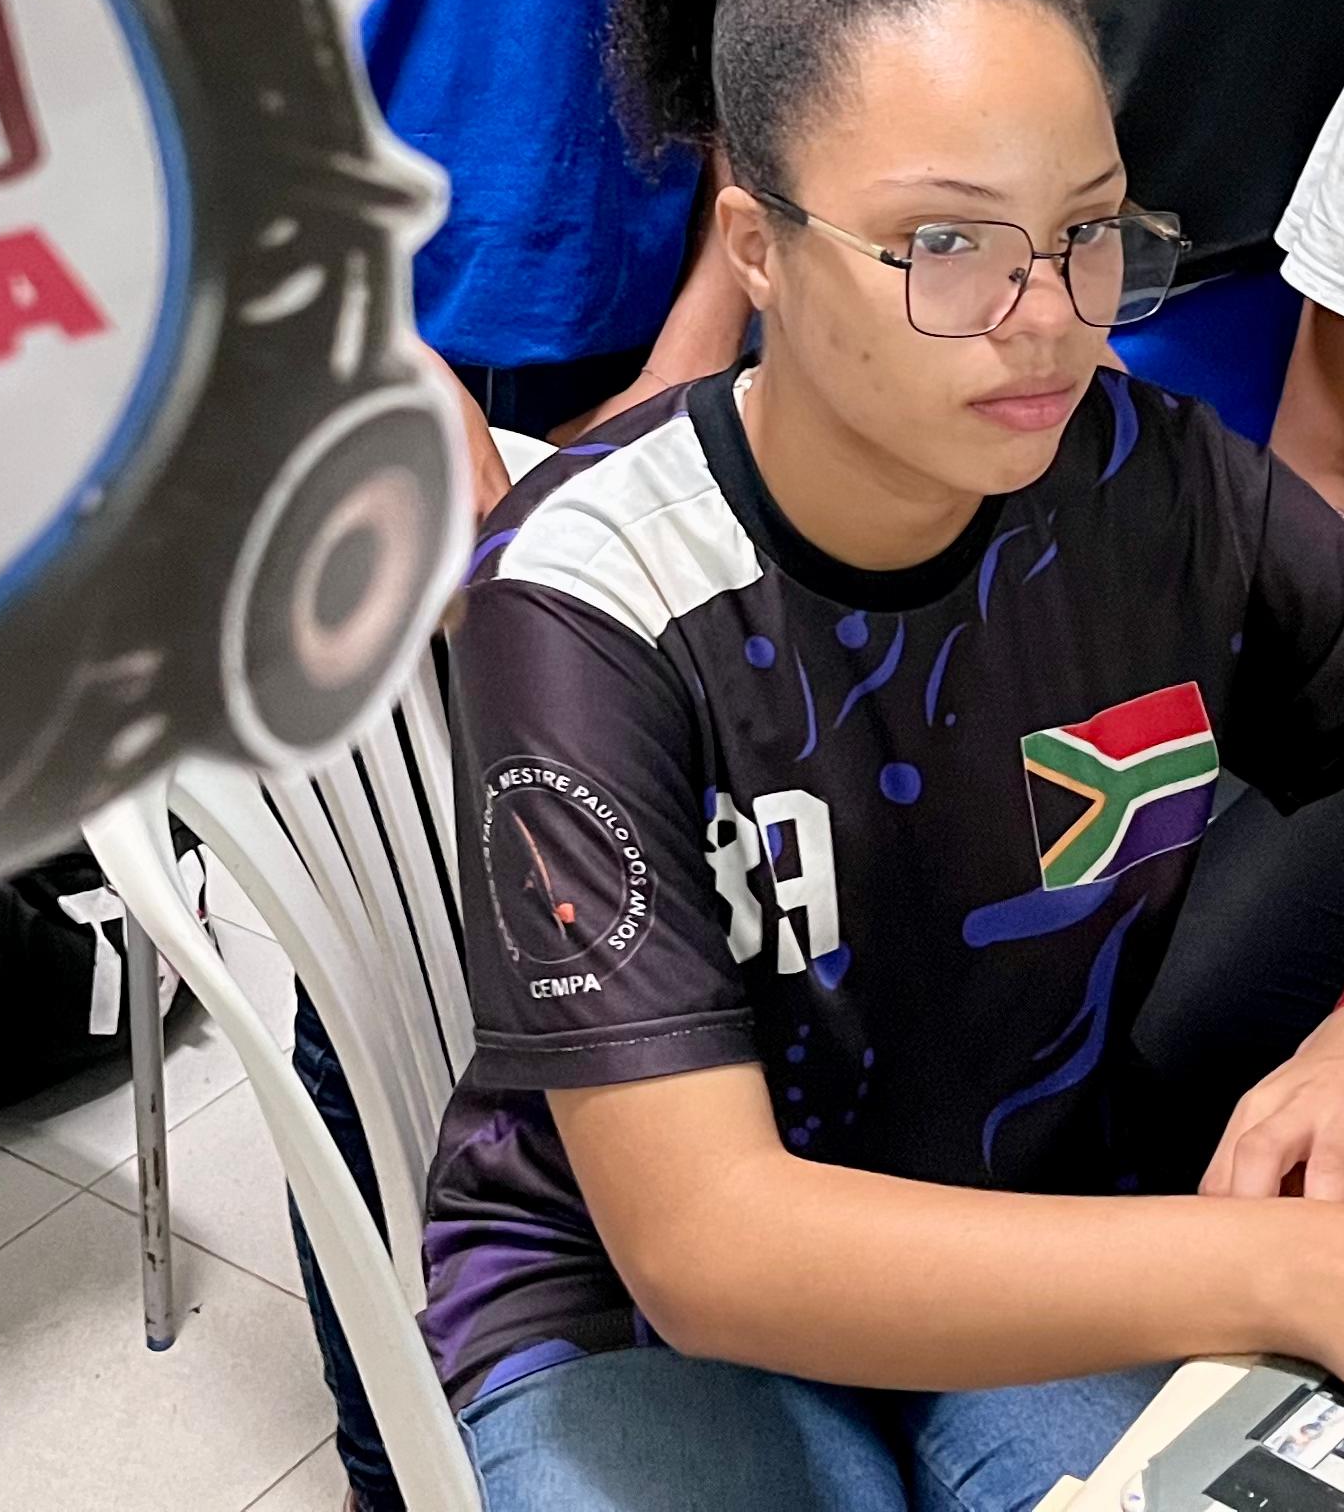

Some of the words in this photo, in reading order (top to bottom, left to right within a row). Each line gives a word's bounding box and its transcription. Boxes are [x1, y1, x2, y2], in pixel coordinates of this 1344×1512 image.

[572, 785, 629, 841] PAULO
[623, 846, 647, 886] DOS
[530, 972, 602, 999] CEMPA
